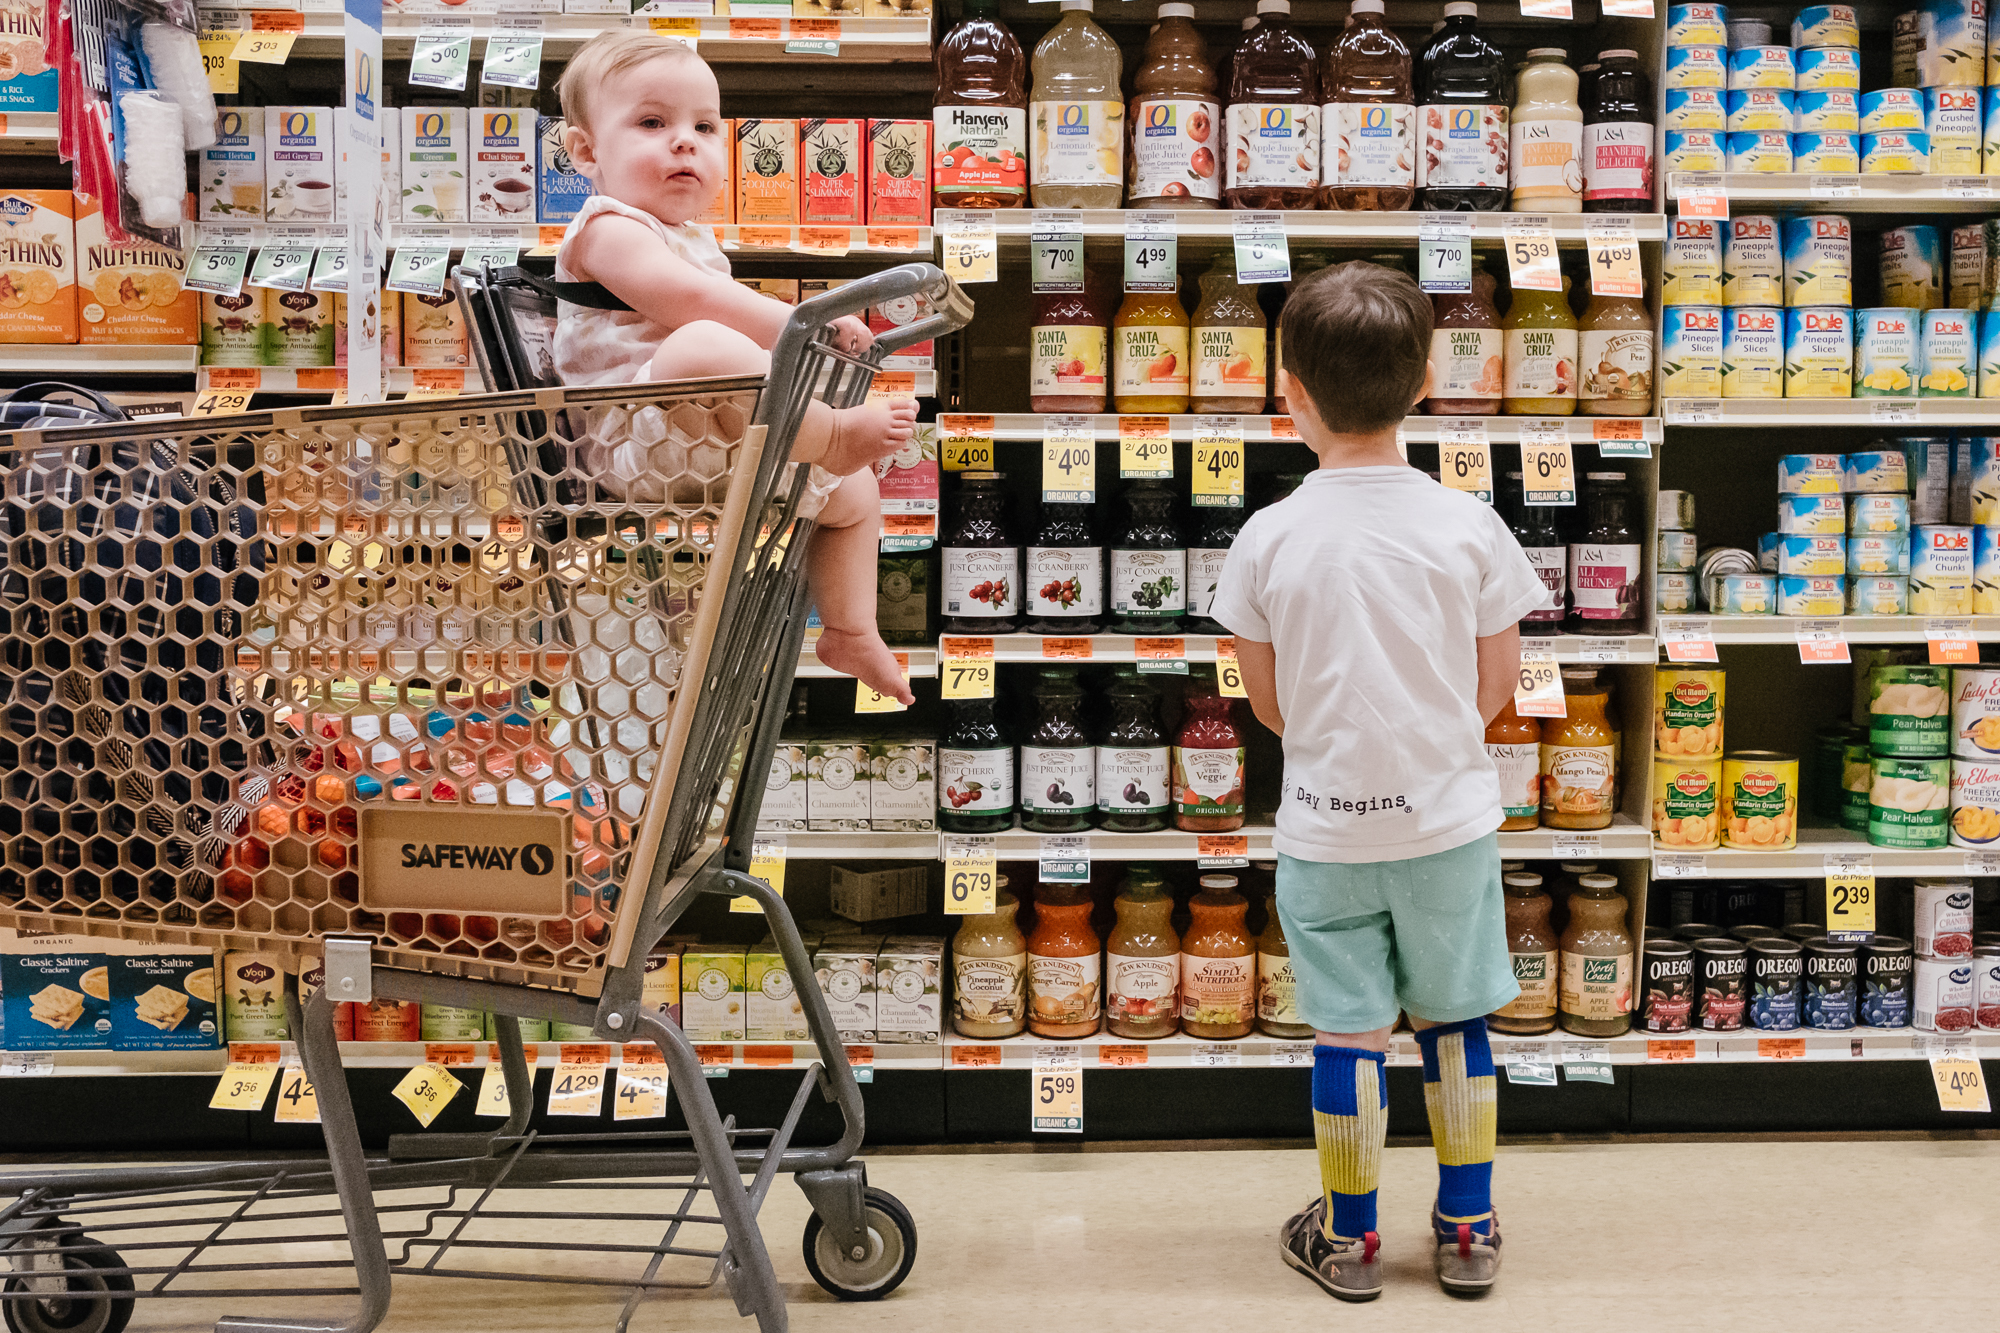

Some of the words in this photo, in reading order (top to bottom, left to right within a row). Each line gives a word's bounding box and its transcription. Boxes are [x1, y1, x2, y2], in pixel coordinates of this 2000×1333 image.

[1692, 8, 1713, 20] Dole
[789, 41, 823, 49] ORGANIC
[1693, 50, 1714, 60] Dole
[1766, 50, 1787, 60] Dole
[1829, 52, 1849, 63] Dole
[115, 62, 137, 79] Coffee
[953, 110, 1009, 129] Hansen's
[1941, 114, 1973, 122] Crushed
[960, 126, 1004, 135] Natural
[281, 137, 314, 145] organics
[417, 138, 449, 146] organics
[485, 138, 517, 146] organics
[964, 139, 998, 148] Organic
[1050, 141, 1096, 149] Lemonade
[1140, 142, 1183, 150] Unfiltered
[1252, 144, 1274, 153] Apple
[1443, 146, 1463, 154] Grape
[1522, 143, 1572, 153] PINEAPPLE
[1596, 146, 1645, 157] CRANBERRY
[228, 152, 252, 160] Herbal
[275, 152, 290, 161] Earl
[291, 153, 309, 162] Grey
[422, 153, 444, 161] Green
[501, 154, 519, 162] Spice
[1139, 151, 1160, 161] Apple
[1522, 154, 1566, 165] COCONUT
[1596, 157, 1637, 168] DELIGHT
[959, 171, 981, 179] Apple
[552, 177, 587, 186] HERBAL
[747, 179, 790, 189] OOLONG
[820, 179, 844, 189] SUPER
[887, 179, 911, 189] SUPER
[547, 185, 591, 195] LAXATIVE
[760, 189, 778, 197] TEA
[809, 188, 854, 199] SLIMMING
[877, 189, 921, 199] SLIMMING
[1689, 197, 1716, 207] gluten
[1695, 205, 1712, 214] free
[1673, 242, 1715, 252] Pineapple
[1732, 242, 1774, 252] Pineapple
[1683, 252, 1707, 260] Slices
[1742, 252, 1766, 260] Slices
[1599, 283, 1620, 292] gluten
[1622, 284, 1635, 292] free
[286, 294, 310, 306] yogi
[107, 316, 140, 324] Cheddar
[141, 315, 166, 324] Cheese
[1037, 331, 1067, 344] SANTA
[1126, 331, 1159, 344] SANTA
[1201, 331, 1233, 344] SANTA
[1450, 332, 1481, 344] SANTA
[1523, 332, 1555, 345] SANTA
[289, 342, 326, 350] Antioxidant
[1039, 344, 1064, 357] CRUZ
[1129, 344, 1156, 357] CRUZ
[1204, 344, 1230, 357] CRUZ
[1453, 344, 1479, 355] CRUZ
[1526, 344, 1552, 355] CRUZ
[1630, 353, 1646, 362] Pear
[1046, 491, 1078, 501] ORGANIC
[950, 563, 966, 574] JUST
[967, 562, 1016, 573] CRANBERRY
[1038, 562, 1091, 572] CRANBERRY
[1116, 567, 1133, 577] JUST
[1135, 567, 1180, 576] CONCORD
[1578, 568, 1598, 576] ALL
[1935, 564, 1965, 572] Chunks
[1578, 577, 1613, 588] PRUNE
[1678, 642, 1704, 651] gluten
[1940, 641, 1967, 650] gluten
[1684, 650, 1701, 658] free
[1946, 651, 1962, 659] free
[1676, 687, 1688, 695] Del
[1689, 688, 1708, 696] Monte
[1958, 682, 1987, 703] Lady
[1666, 711, 1692, 719] Mandarin
[1694, 711, 1715, 719] Oranges
[1893, 719, 1912, 728] Pear
[1913, 719, 1942, 728] Halves
[943, 766, 958, 775] TART
[960, 766, 995, 776] CHERRY
[1026, 764, 1039, 774] JUST
[1041, 765, 1068, 774] PRUNE
[1070, 765, 1088, 773] JUICE
[1102, 764, 1116, 774] JUST
[1117, 765, 1145, 774] PRUNE
[1146, 765, 1164, 773] JUICE
[1555, 767, 1585, 778] Mango
[1586, 768, 1605, 776] Peach
[1197, 772, 1227, 781] Veggie
[1678, 778, 1690, 786] Del
[1692, 778, 1709, 786] Monte
[1744, 778, 1757, 786] Del
[1759, 778, 1776, 786] Monte
[1297, 786, 1319, 810] Day
[811, 800, 860, 809] Chamomile
[875, 800, 923, 809] Chamomile
[1666, 801, 1692, 809] Mandarin
[1693, 801, 1715, 809] Oranges
[1195, 807, 1227, 815] ORIGINAL
[1882, 812, 1902, 823] Pear
[1904, 813, 1934, 823] Halves
[401, 843, 518, 871] SAFEWAY
[20, 957, 53, 967] Classic
[56, 957, 89, 967] Saltine
[125, 959, 158, 968] Classic
[160, 959, 193, 967] Saltine
[1516, 959, 1544, 971] North
[1202, 966, 1242, 977] SIMPLY
[1516, 967, 1542, 977] Coast
[1586, 961, 1615, 974] North
[967, 975, 1005, 985] Pineapple
[1193, 973, 1247, 984] NUTRITIOUS
[1586, 972, 1612, 980] Coast
[1030, 977, 1055, 986] Orange
[1057, 978, 1080, 987] Carrot
[1133, 979, 1158, 988] Apple
[896, 1017, 927, 1025] Lavender
